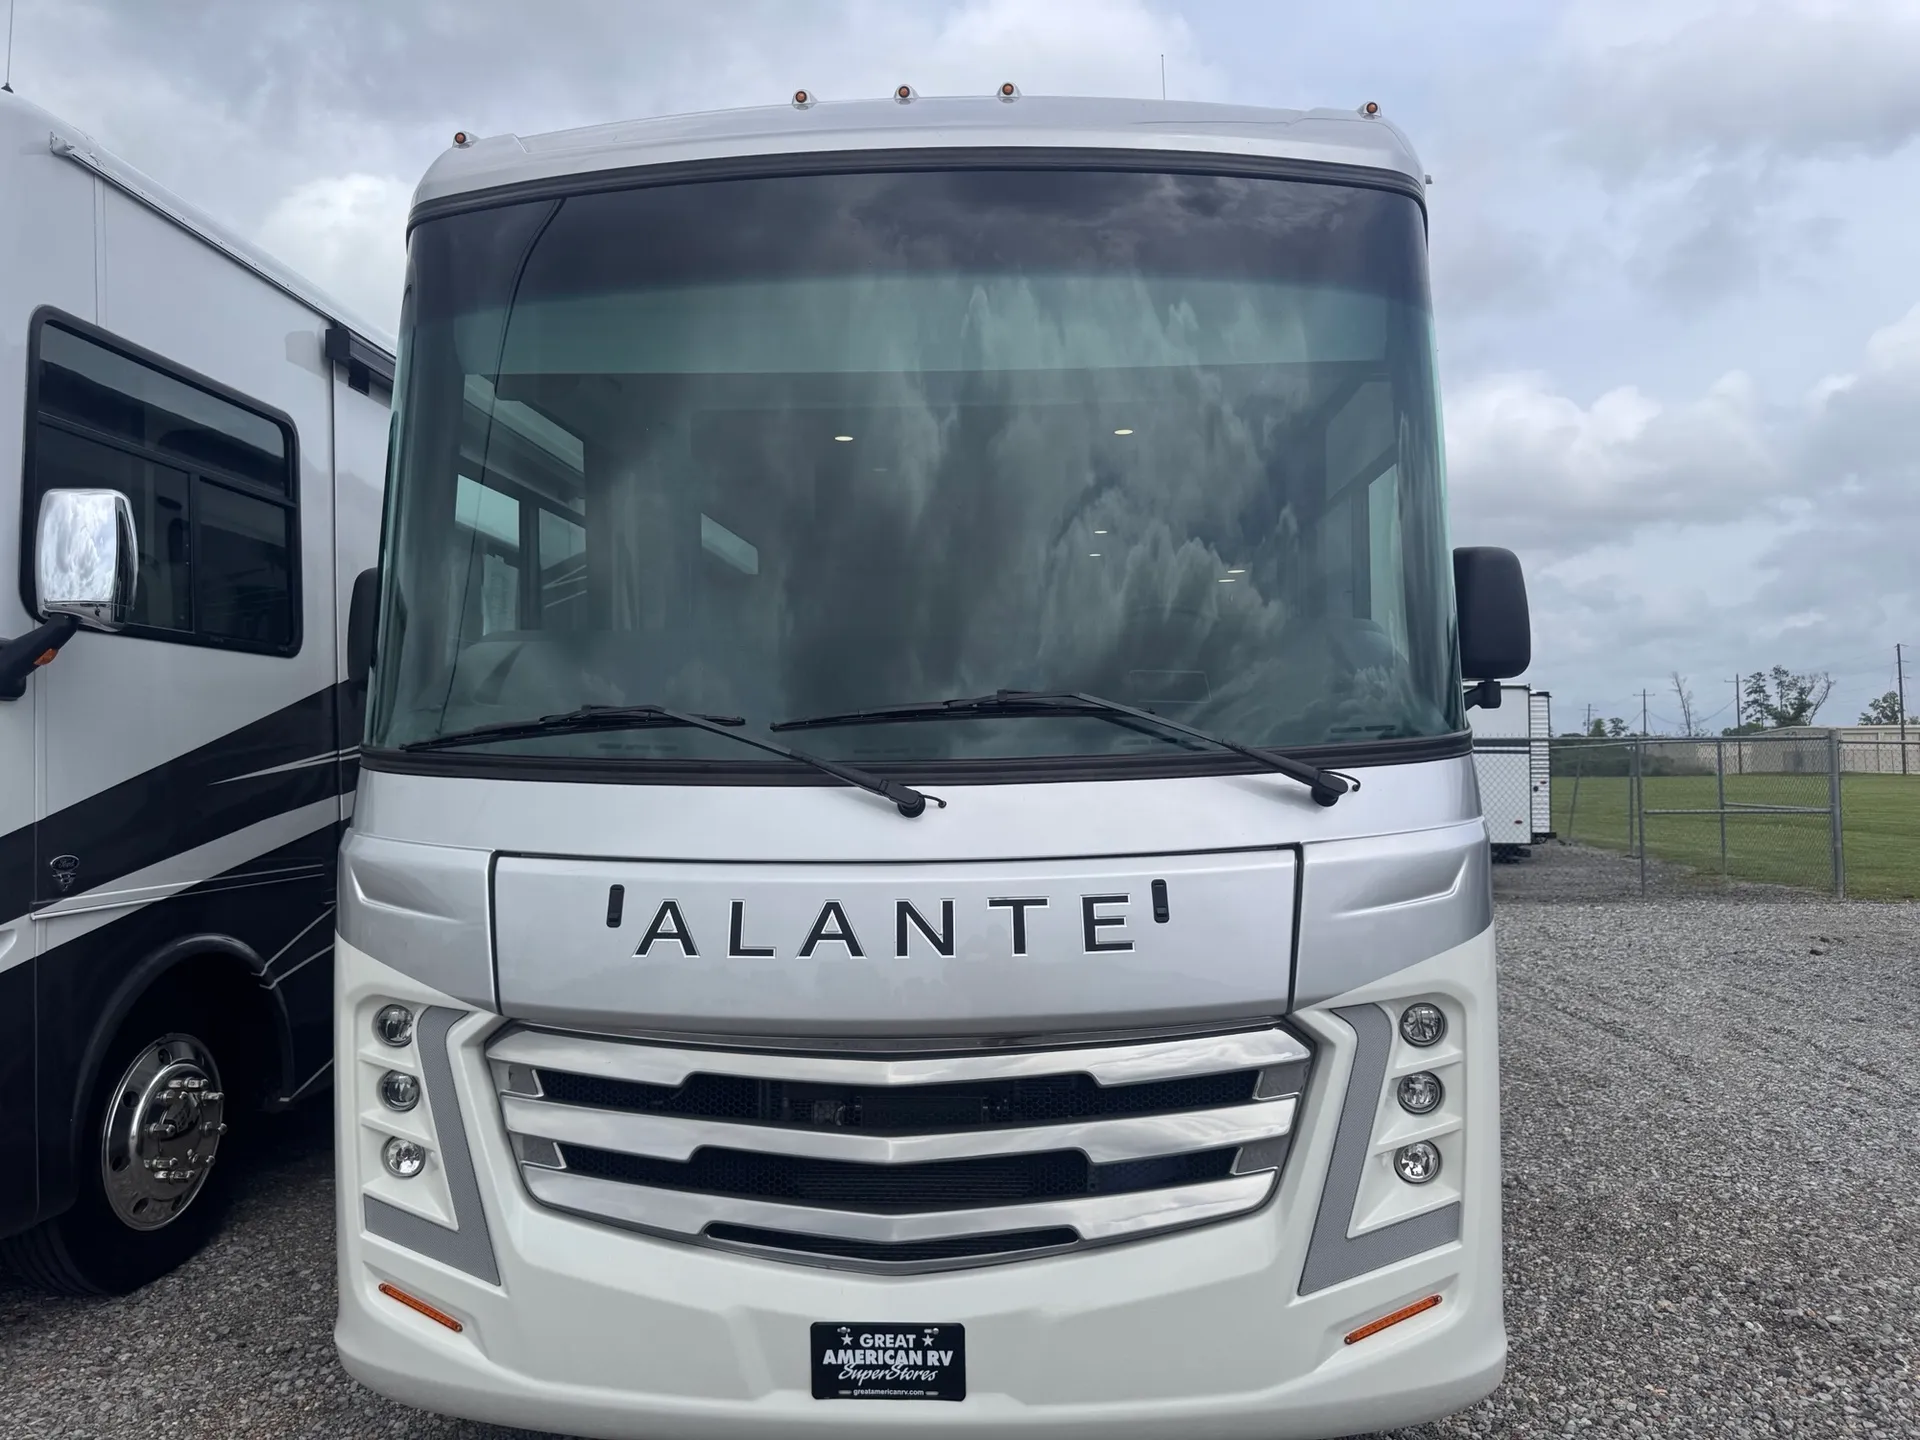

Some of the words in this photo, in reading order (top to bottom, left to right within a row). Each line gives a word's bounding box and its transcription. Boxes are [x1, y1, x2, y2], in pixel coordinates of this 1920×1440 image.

[632, 893, 1136, 959] ALANTE
[859, 1333, 916, 1348] GREAT
[822, 1349, 922, 1366] AMERICAN
[926, 1350, 953, 1366] RV
[838, 1363, 938, 1386] SuperStores
[853, 1388, 924, 1397] greatamericanrv.com
